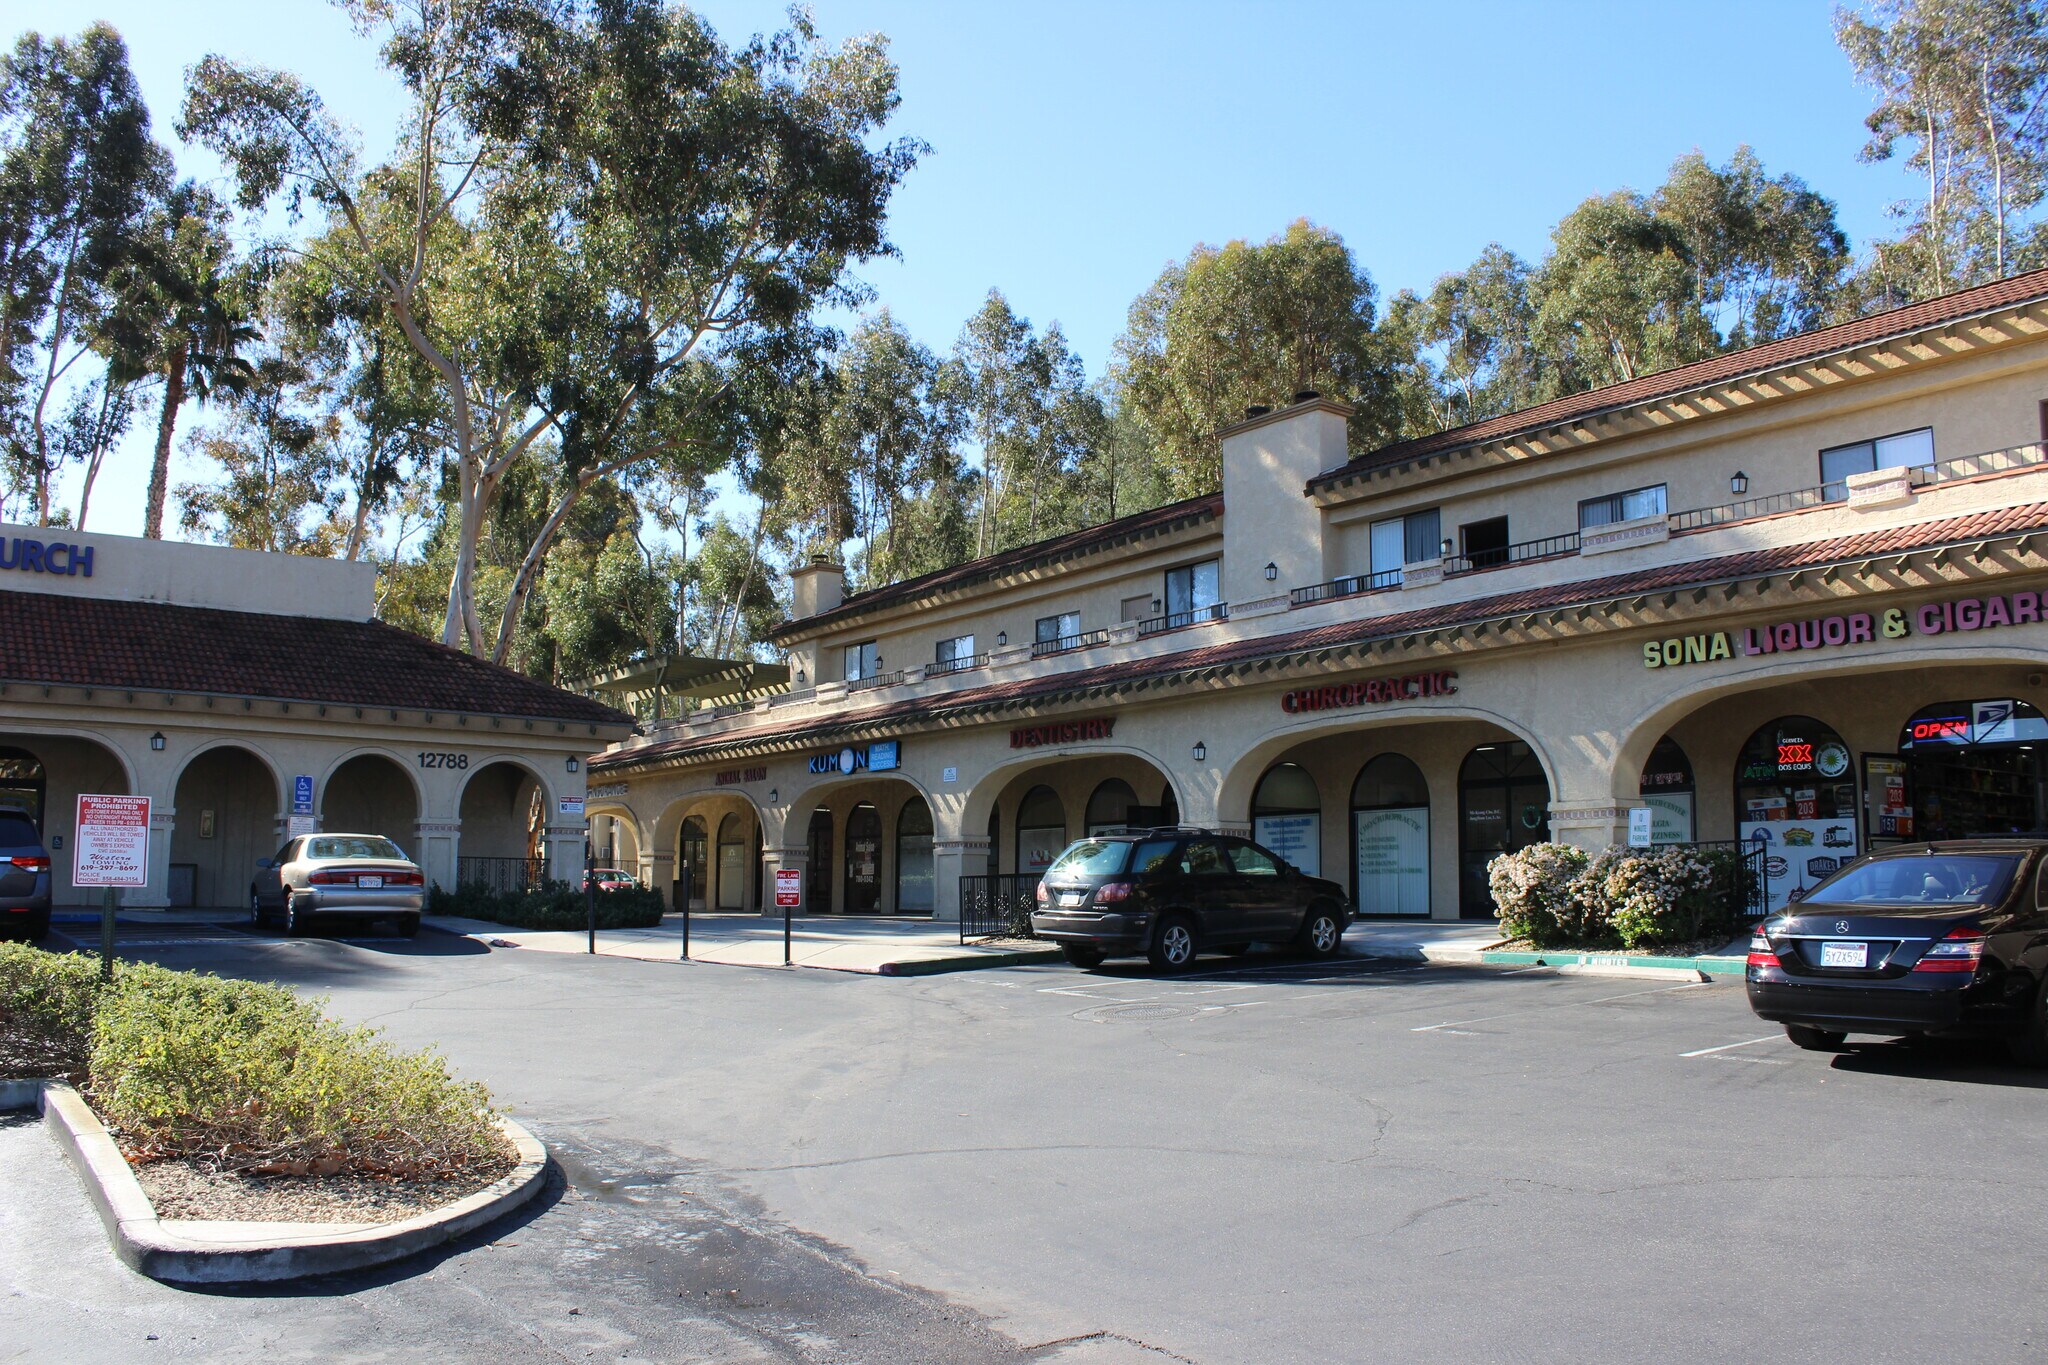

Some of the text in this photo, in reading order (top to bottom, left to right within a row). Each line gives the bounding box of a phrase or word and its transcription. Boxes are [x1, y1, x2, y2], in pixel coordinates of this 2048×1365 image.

[0, 536, 94, 577] URCH
[1644, 632, 1730, 668] SONA
[1744, 612, 1874, 656] LIQUOR
[1882, 608, 1907, 638] &
[1282, 671, 1458, 713] CHIROPRACTIC
[1010, 719, 1116, 748] DENTISTRY
[1914, 722, 1967, 738] OPEN
[1778, 744, 1812, 763] XX
[418, 752, 468, 769] 12788
[809, 747, 865, 774] KUMON
[1744, 766, 1775, 778] ATM
[1890, 790, 1902, 802] 203
[1798, 802, 1814, 814] 203
[1639, 814, 1643, 822] 10
[1750, 812, 1766, 821] 153
[1780, 810, 1785, 820] 9
[1883, 818, 1895, 831] 153
[1908, 820, 1912, 832] 9
[1578, 956, 1628, 966] 10 MINUTES
[1825, 951, 1863, 962] 5YZX594
